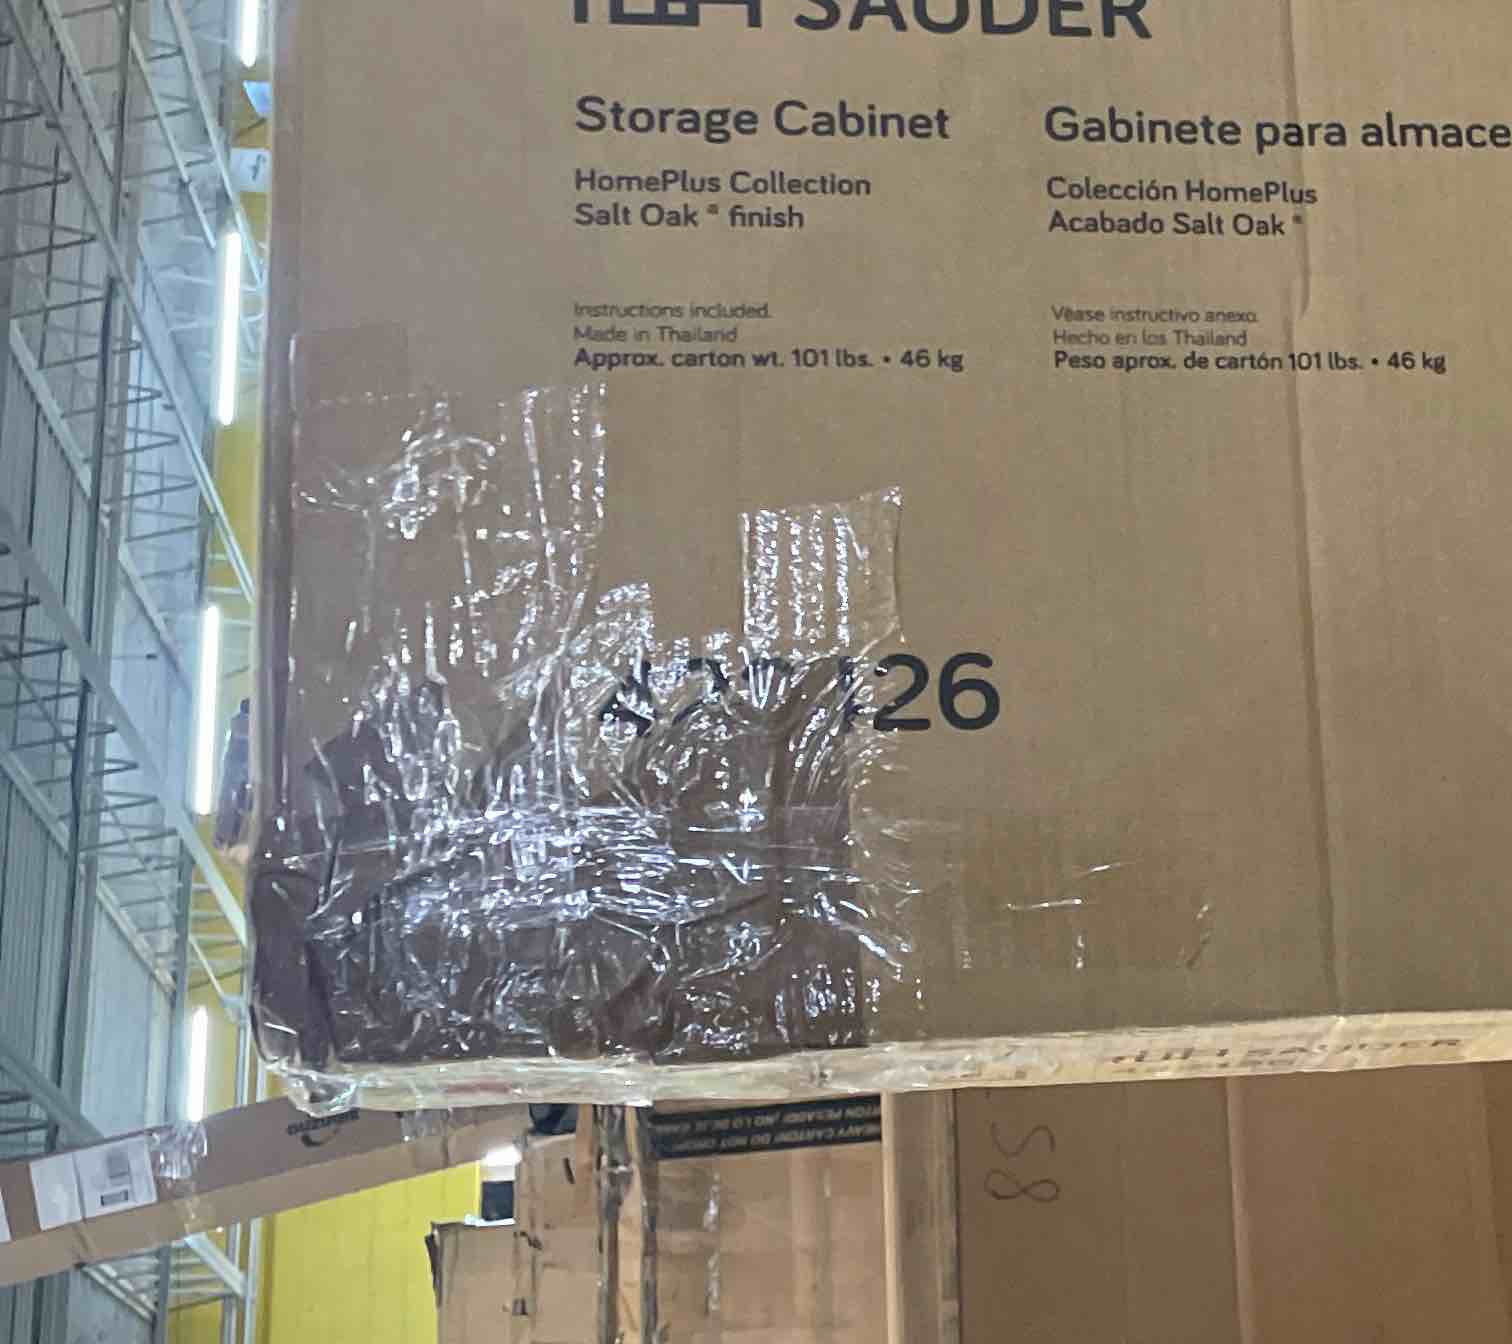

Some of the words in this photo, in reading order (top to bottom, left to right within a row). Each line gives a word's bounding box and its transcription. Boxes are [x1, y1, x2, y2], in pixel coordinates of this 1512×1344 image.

[575, 95, 759, 145] Storage
[774, 99, 950, 140] Cabinet
[1044, 105, 1242, 146] Gabinete
[1255, 121, 1347, 156] para
[575, 167, 722, 193] HomePlus
[729, 170, 871, 196] Collection
[1046, 175, 1178, 201] Colección
[1185, 179, 1318, 205] HomePlus
[574, 201, 631, 227] Salt
[728, 204, 805, 229] finish
[1048, 209, 1165, 235] Acabado
[1172, 211, 1225, 235] Salt
[573, 301, 684, 319] Instructions
[1109, 307, 1201, 323] instructivo
[573, 324, 628, 343] Made
[633, 329, 651, 342] in
[655, 325, 739, 344] Thailand
[1052, 328, 1111, 345] Hecho
[1114, 332, 1138, 346] en
[1141, 328, 1168, 346] los
[1172, 328, 1248, 348] Thailand
[573, 347, 665, 372] Approx.
[671, 351, 746, 368] carton
[751, 351, 785, 367] wt.
[791, 347, 829, 368] 101
[835, 348, 874, 368] lbs.
[899, 348, 931, 369] 46
[937, 348, 964, 373] kg
[1054, 349, 1106, 369] Peso
[1111, 355, 1177, 374] aprox.
[1183, 350, 1210, 370] de
[1214, 351, 1284, 371] cartón
[1287, 351, 1322, 372] 101
[1327, 351, 1364, 371] lbs.
[1387, 351, 1416, 370] 46
[1421, 351, 1447, 375] kg
